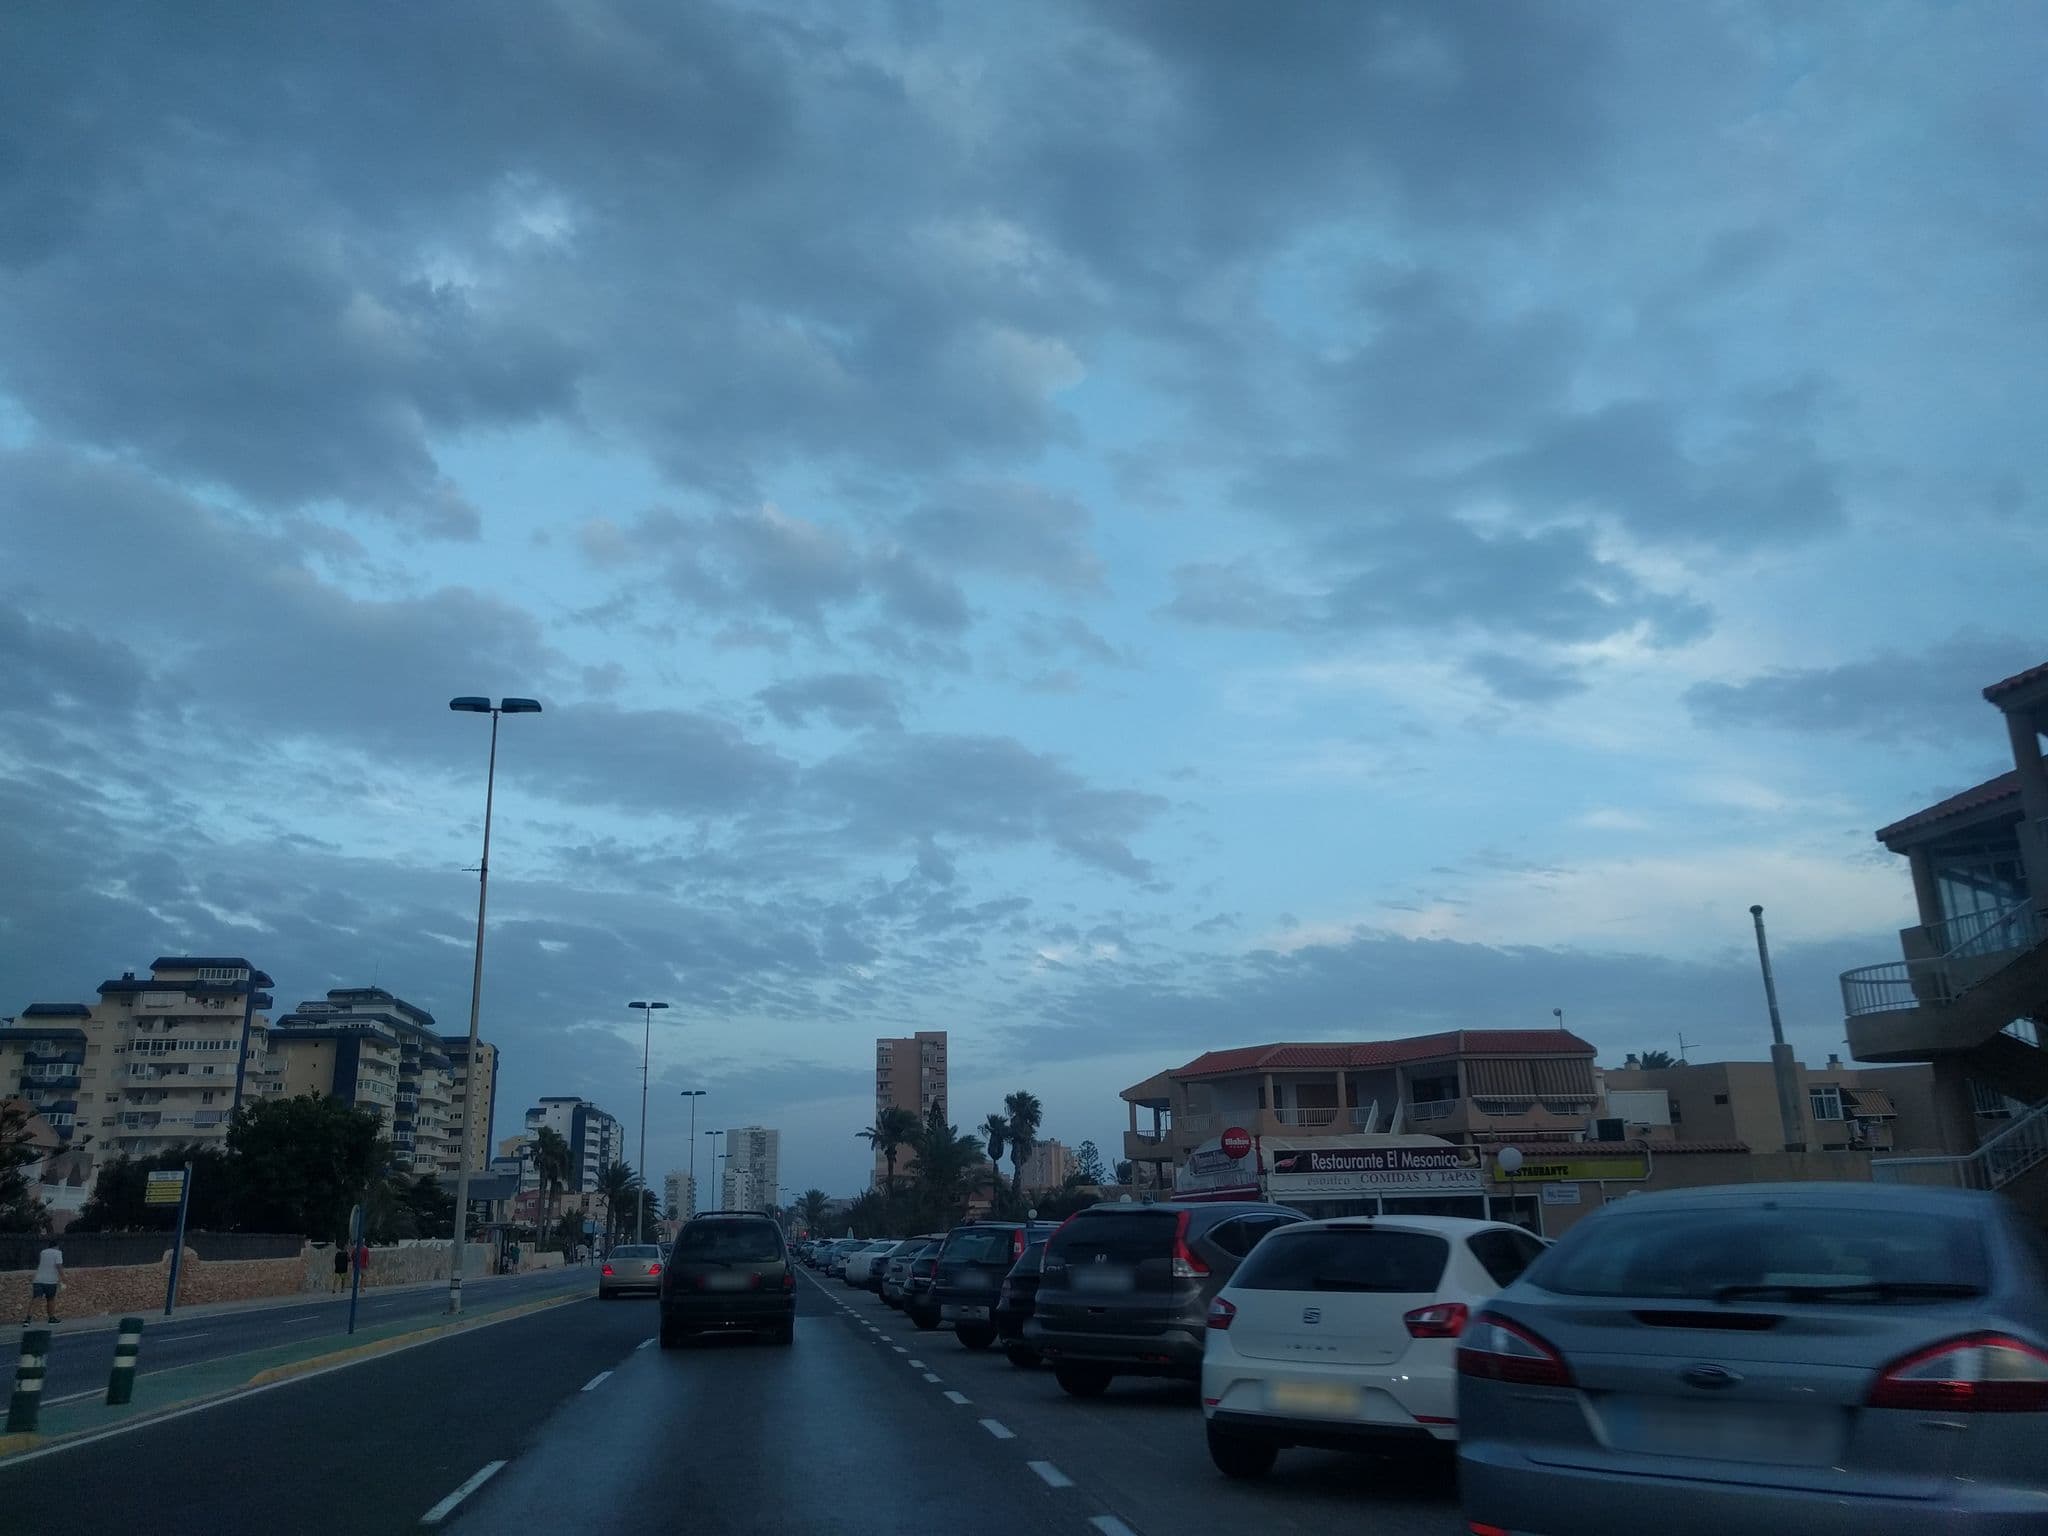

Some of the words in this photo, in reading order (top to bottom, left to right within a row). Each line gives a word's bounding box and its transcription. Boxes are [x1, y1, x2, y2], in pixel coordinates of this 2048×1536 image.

[1311, 1152, 1384, 1170] Restaurante
[1386, 1150, 1398, 1168] El
[1401, 1149, 1458, 1168] Mesonico
[1360, 1171, 1420, 1184] COMIDAS
[1425, 1172, 1433, 1182] Y
[1440, 1171, 1477, 1182] TAPAS
